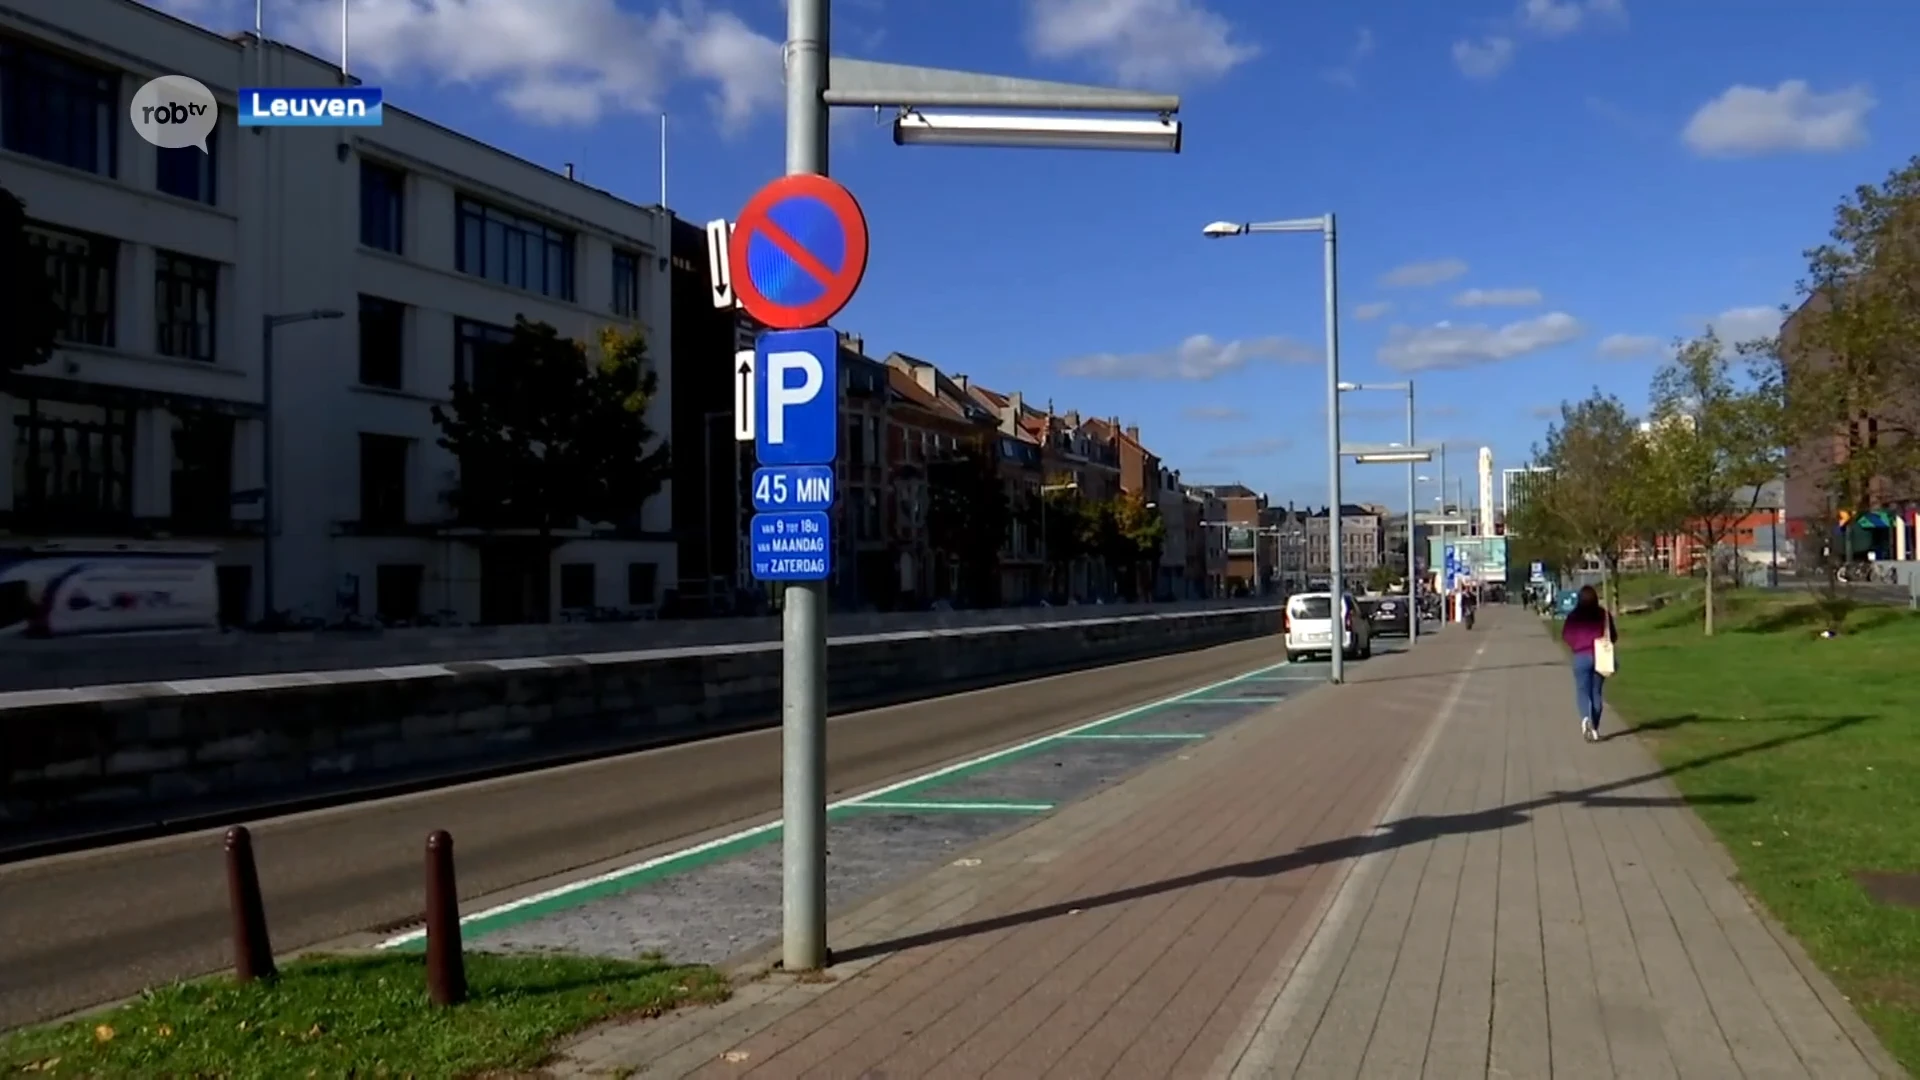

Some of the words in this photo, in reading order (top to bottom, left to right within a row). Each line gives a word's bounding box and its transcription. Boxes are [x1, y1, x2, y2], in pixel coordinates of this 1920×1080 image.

[767, 351, 824, 444] P
[755, 474, 788, 504] 45
[796, 477, 830, 503] MIN
[776, 519, 784, 534] 9
[772, 537, 824, 552] MAANDAG
[771, 558, 825, 573] ZATERDAG
